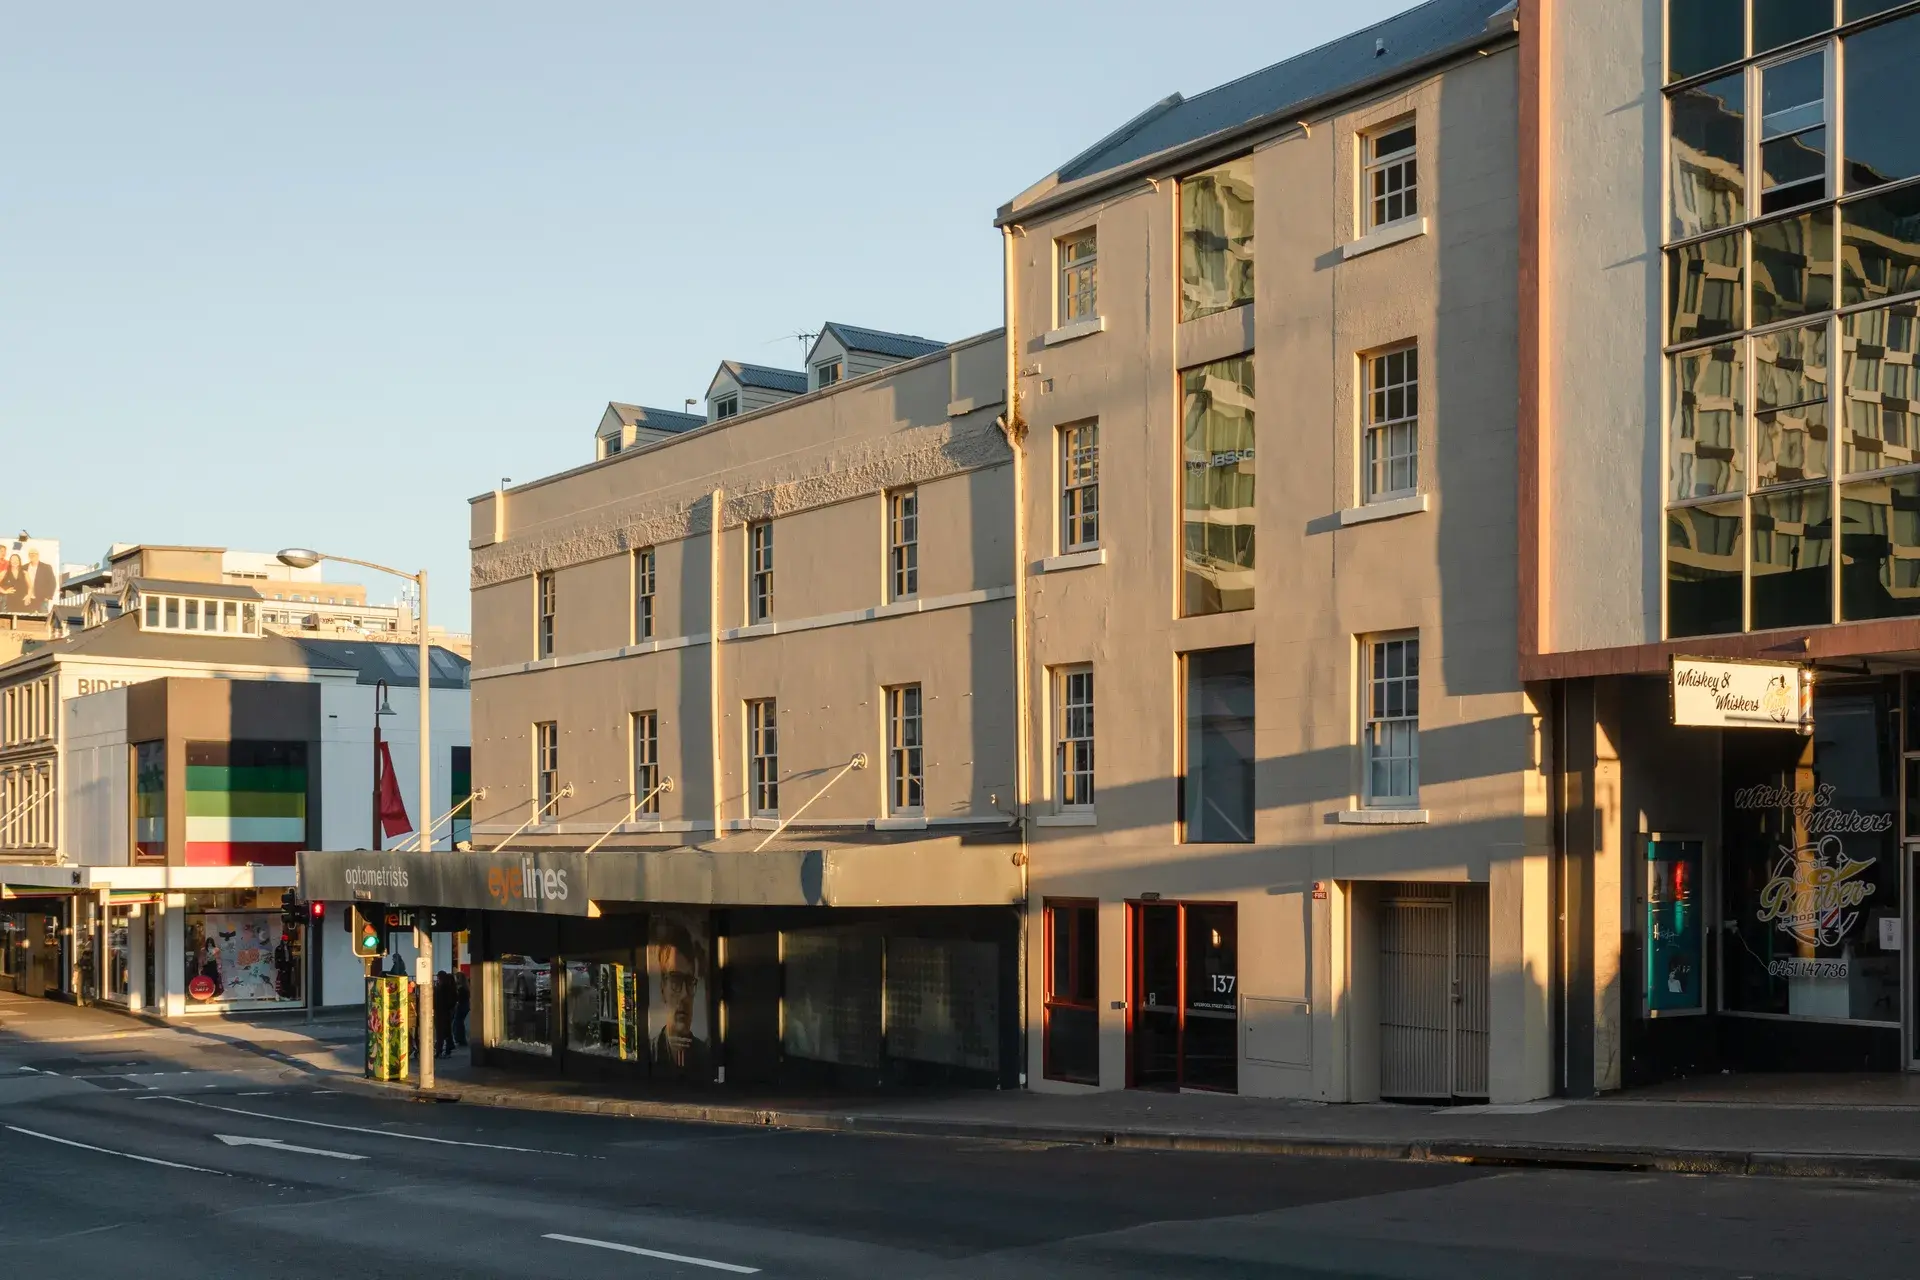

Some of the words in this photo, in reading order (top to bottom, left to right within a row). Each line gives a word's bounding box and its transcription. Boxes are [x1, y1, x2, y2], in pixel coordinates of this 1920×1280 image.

[1677, 669, 1719, 696] Whiskey
[1721, 672, 1731, 688] &
[1715, 692, 1760, 712] Whiskers
[1735, 784, 1812, 816] Whiskey
[1814, 783, 1836, 806] &
[1802, 808, 1892, 832] Whiskers
[345, 866, 409, 889] optometrists
[488, 857, 568, 905] eyelines
[1757, 867, 1876, 921] Barber
[1768, 960, 1798, 976] 0451
[1800, 961, 1822, 978] 147
[1823, 963, 1848, 978] 736
[1211, 974, 1236, 993] 137
